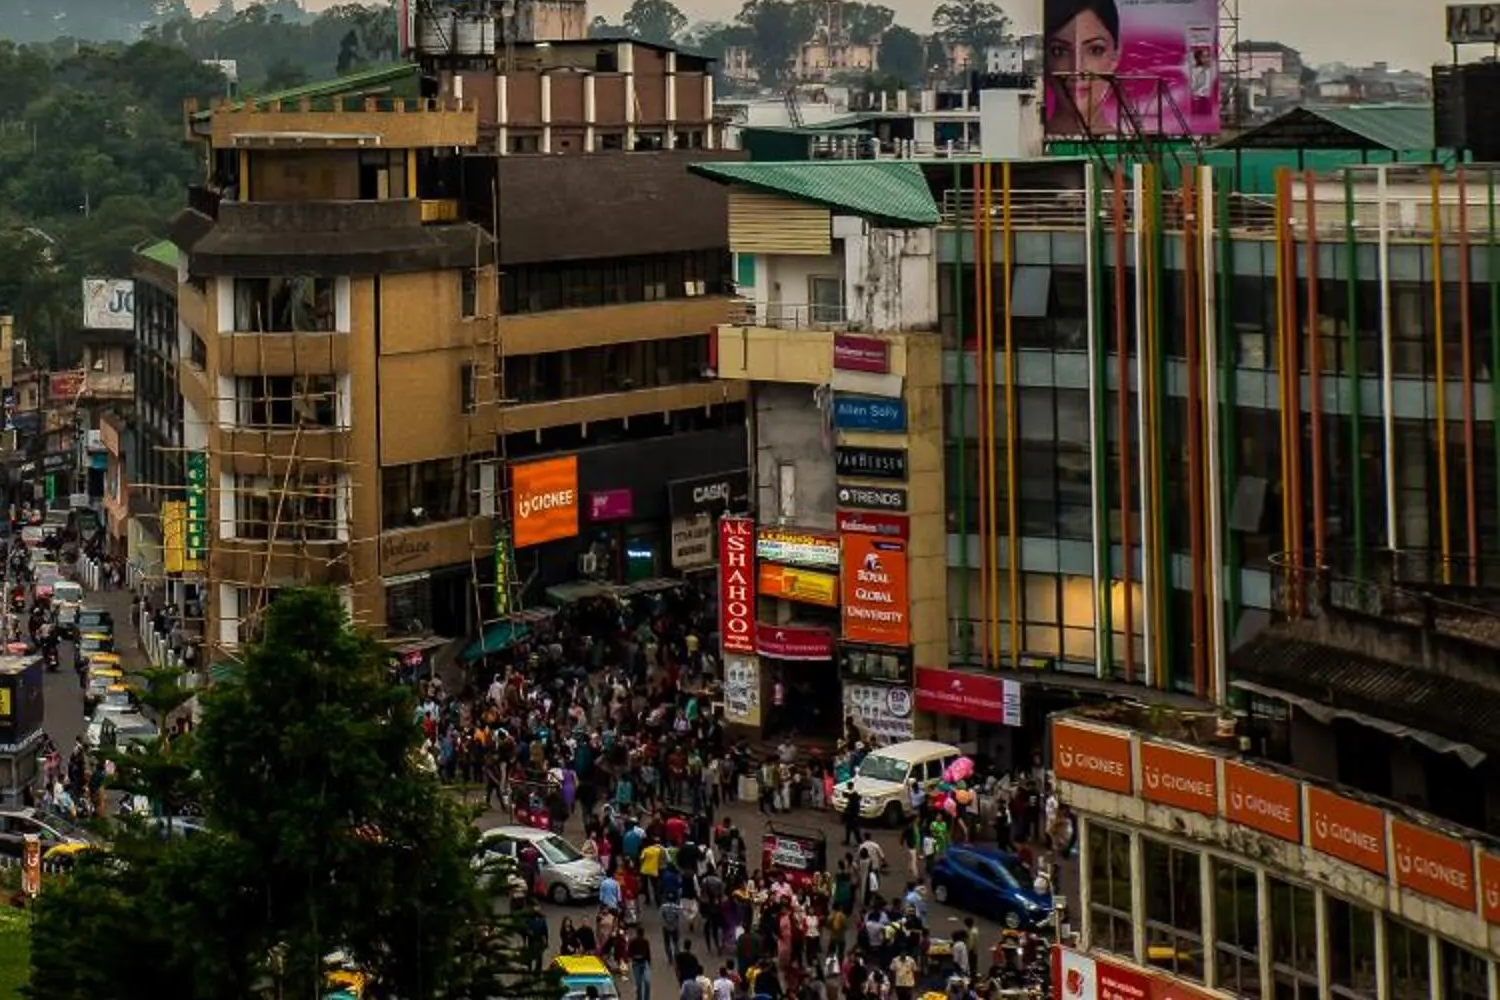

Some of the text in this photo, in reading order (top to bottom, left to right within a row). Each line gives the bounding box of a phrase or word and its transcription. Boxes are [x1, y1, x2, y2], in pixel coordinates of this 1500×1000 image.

[837, 403, 899, 418] Allen Solly
[531, 489, 573, 511] GIONEE
[693, 482, 729, 503] CASIO
[850, 489, 901, 506] TRENDS
[727, 535, 748, 633] SHAHOO
[1075, 755, 1125, 777] GIONEE
[1161, 773, 1214, 797] GIONEE
[1244, 795, 1293, 823] GIONEE
[1329, 823, 1379, 853] GIONEE
[1413, 856, 1469, 890] GIONEE
